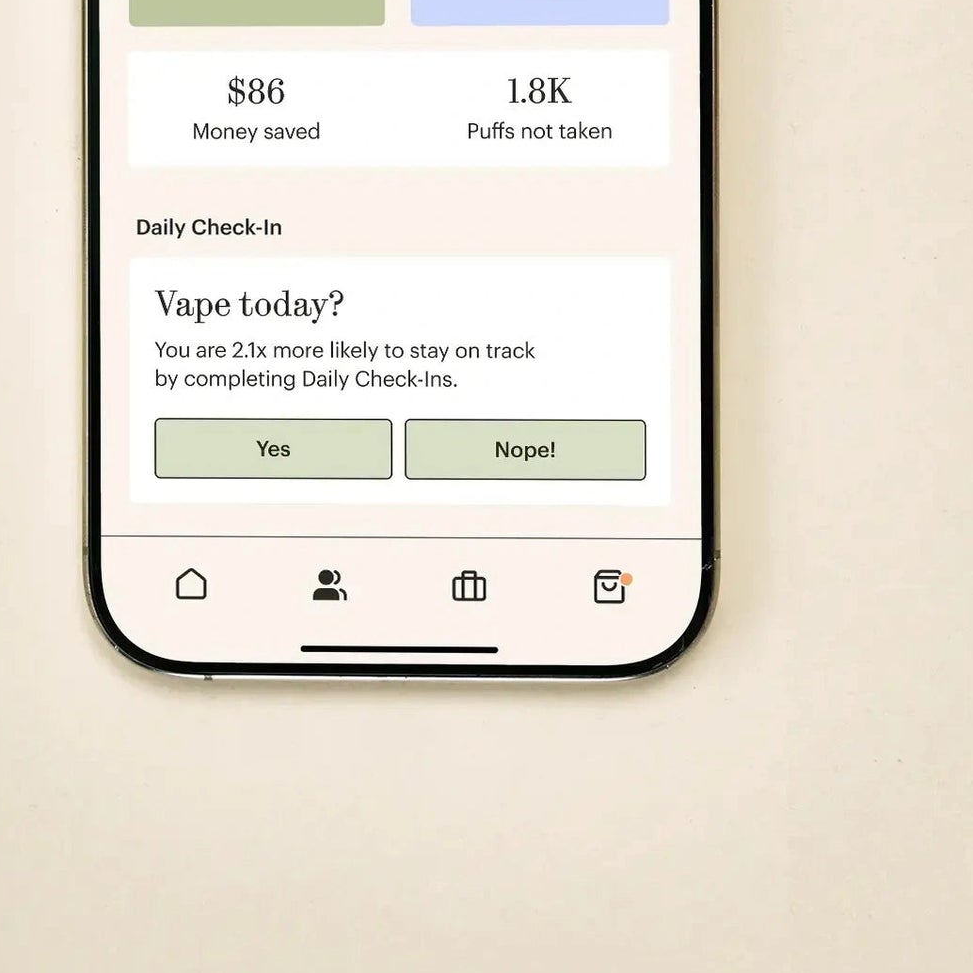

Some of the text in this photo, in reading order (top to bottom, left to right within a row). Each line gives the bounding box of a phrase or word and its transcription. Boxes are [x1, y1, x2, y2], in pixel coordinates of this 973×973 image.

[227, 74, 285, 108] $86
[507, 76, 573, 105] 1.8K
[193, 121, 321, 144] Money saved
[467, 120, 613, 140] Puffs not taken
[136, 217, 282, 240] Daily Check-In
[154, 289, 345, 325] Vape today?
[154, 340, 536, 363] You are 2.1x more likely to stay on track
[155, 368, 458, 392] by completing Daily Check-Ins.
[255, 440, 291, 458] Yes
[495, 440, 556, 462] Nope!
